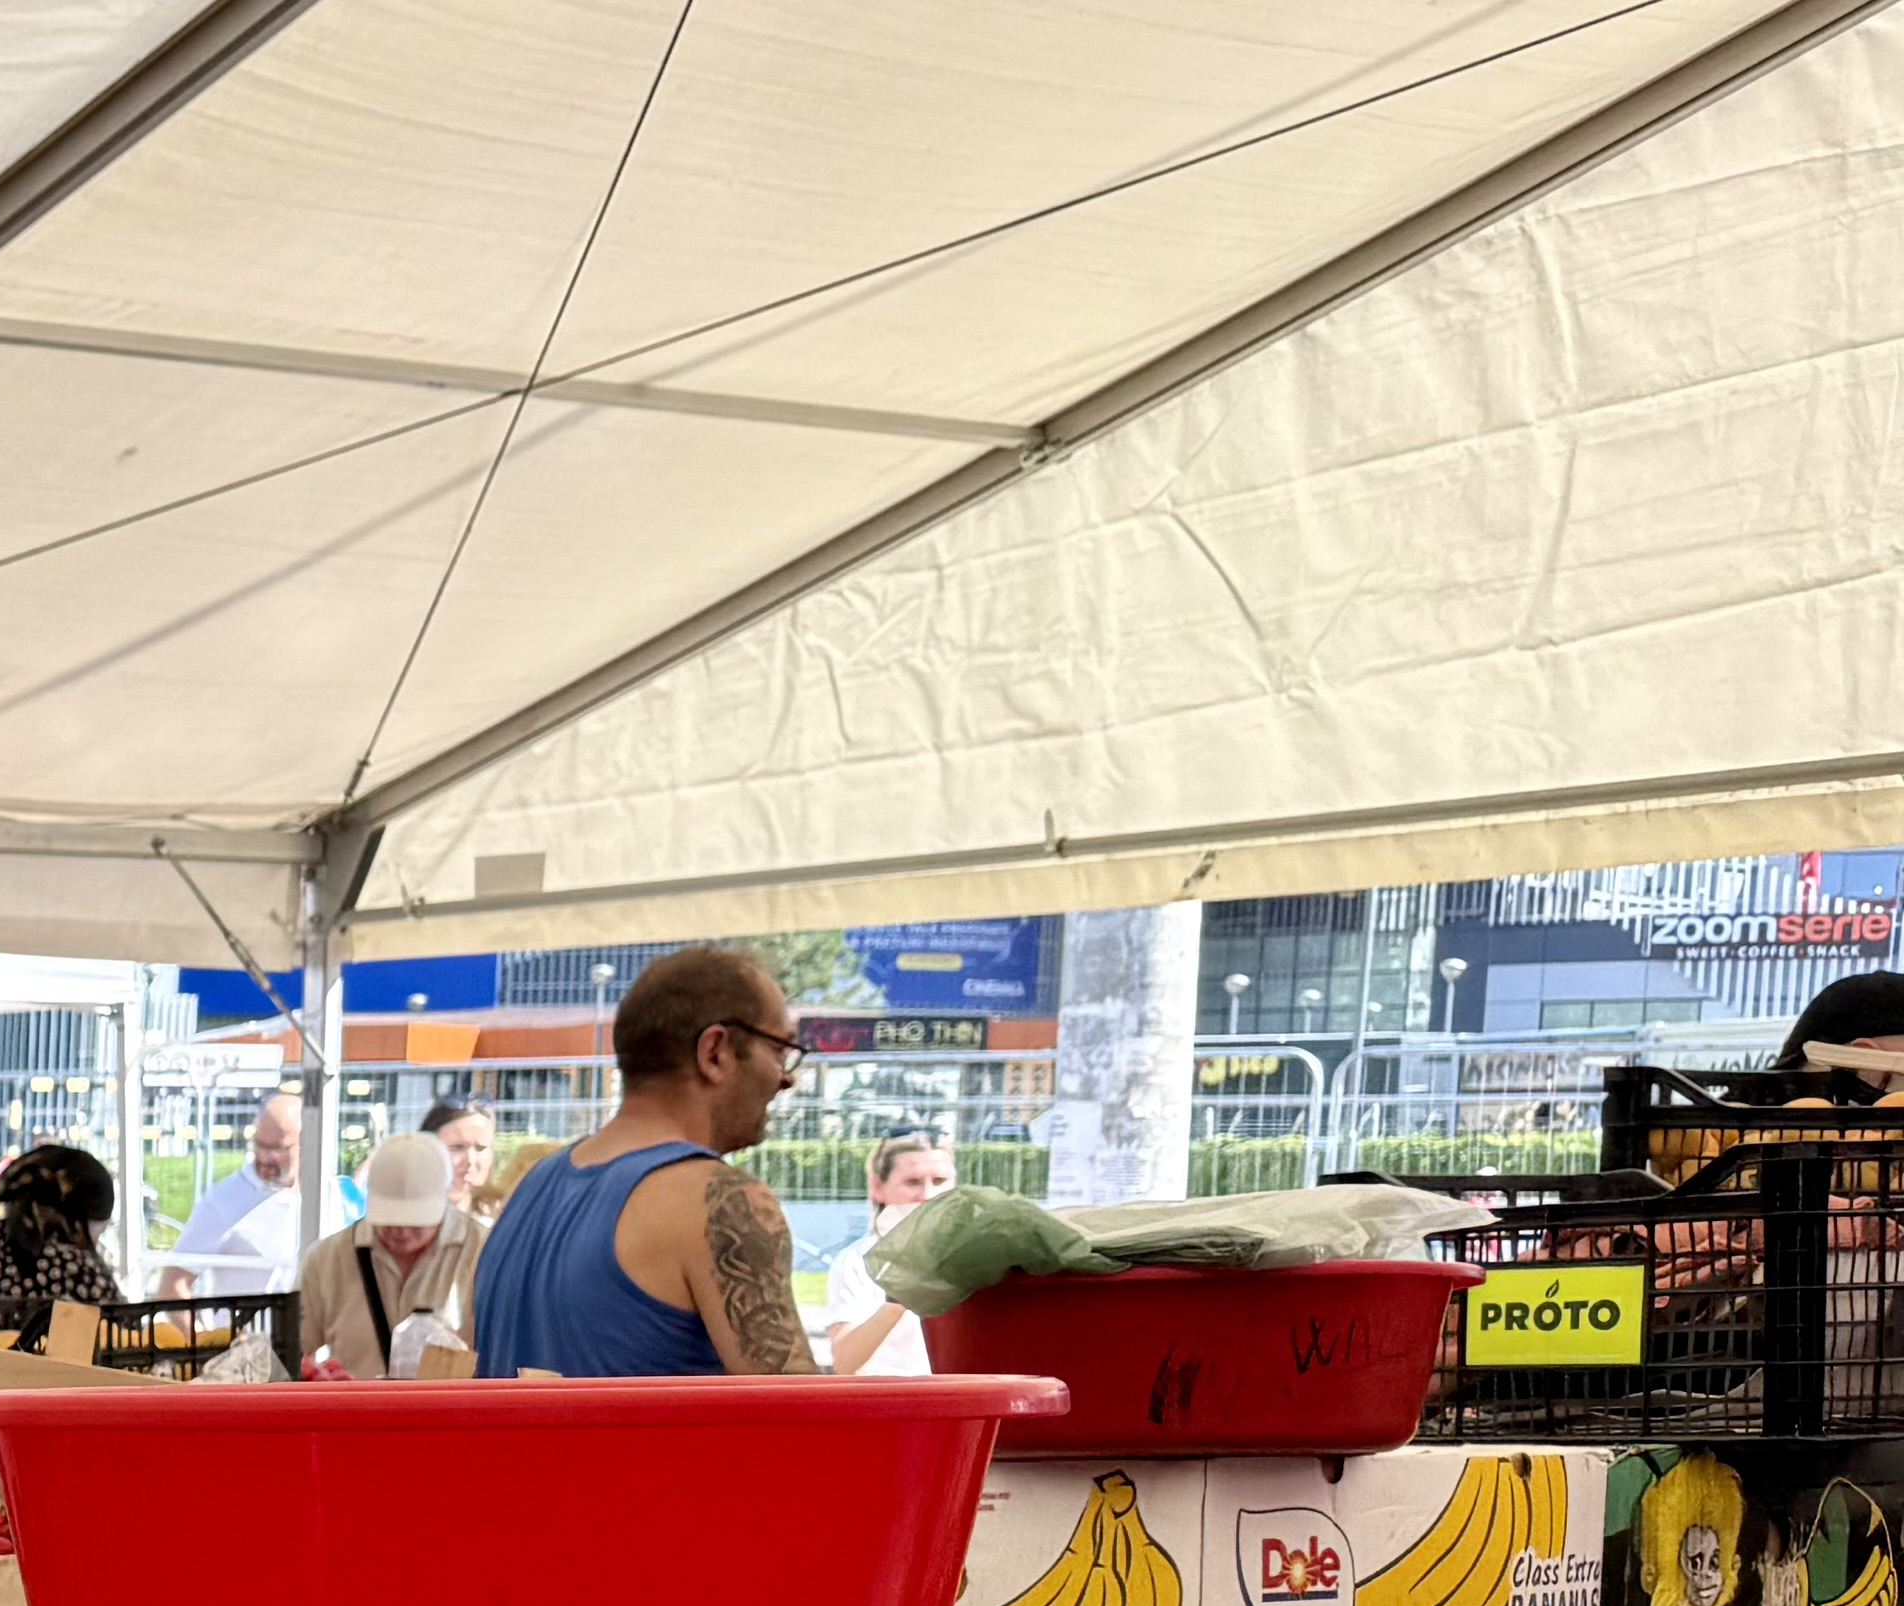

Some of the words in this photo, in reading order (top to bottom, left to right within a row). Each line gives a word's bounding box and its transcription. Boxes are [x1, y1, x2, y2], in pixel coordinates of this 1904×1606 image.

[1652, 914, 1891, 945] zoomserie
[1676, 946, 1727, 960] SWEET
[1738, 945, 1796, 959] COFFEE
[1808, 944, 1861, 958] SNACK
[1262, 1535, 1341, 1595] Dole
[1512, 1552, 1560, 1588] Class
